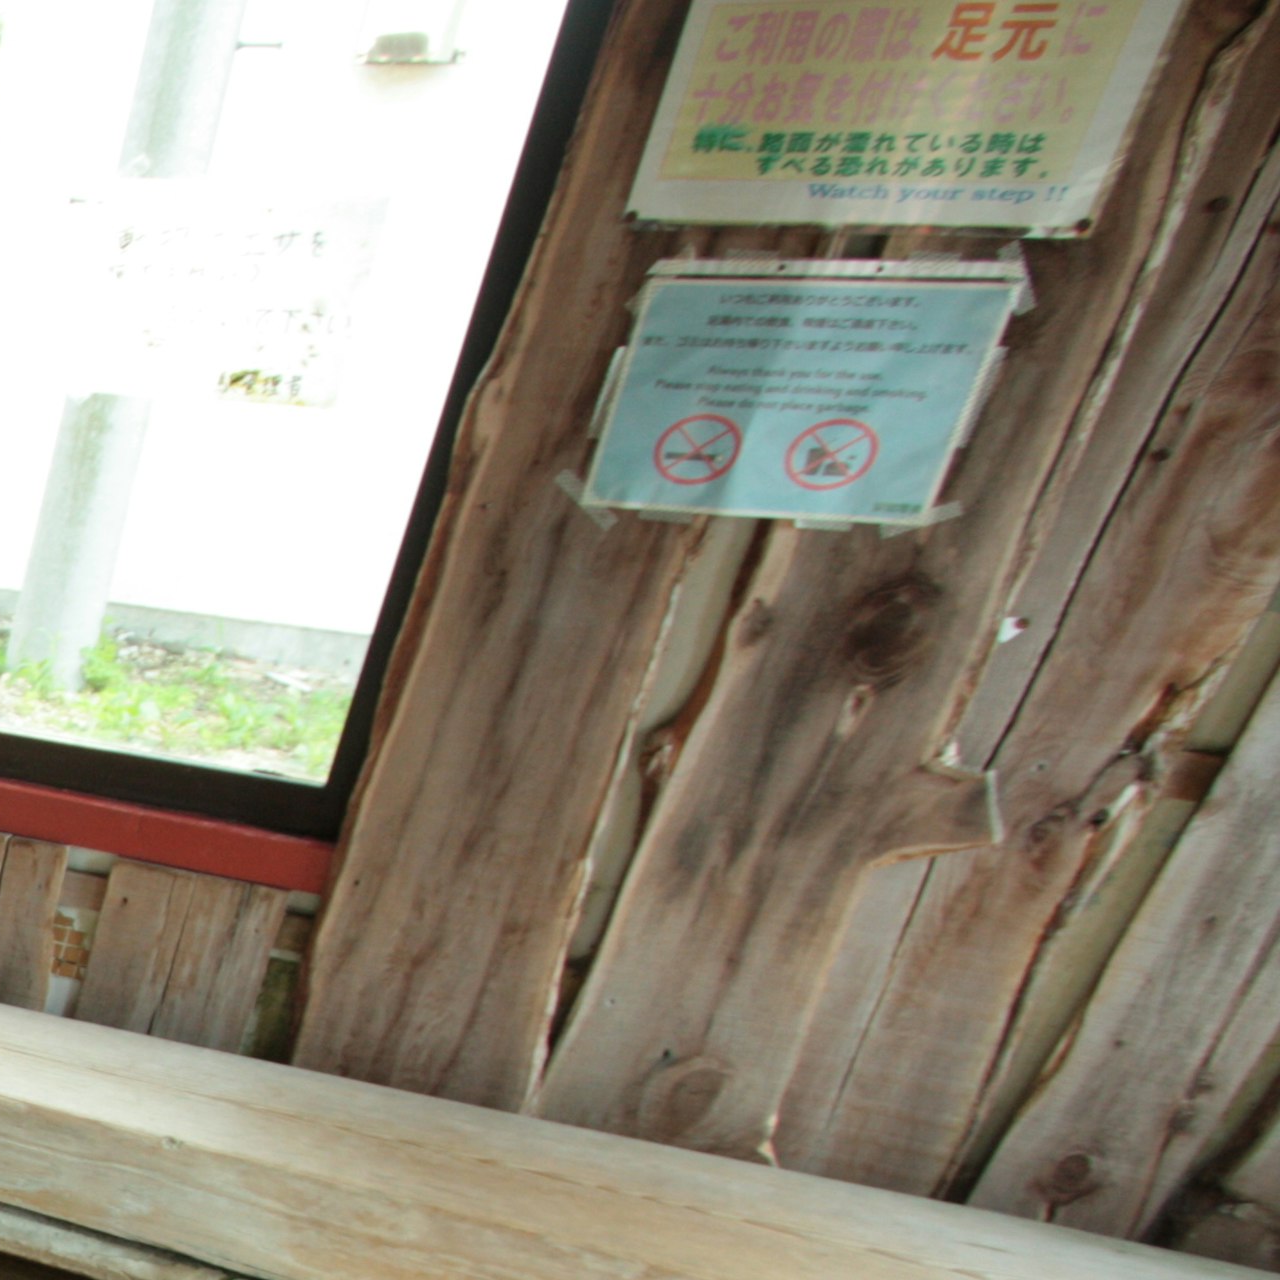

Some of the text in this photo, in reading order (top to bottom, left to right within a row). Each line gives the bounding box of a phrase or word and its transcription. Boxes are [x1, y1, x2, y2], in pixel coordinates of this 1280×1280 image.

[716, 2, 1108, 64] ご利用の際は、足元に
[691, 69, 1074, 125] 十分お気を付けください。
[808, 184, 888, 199] Watch
[896, 186, 965, 202] your
[971, 187, 1037, 204] step
